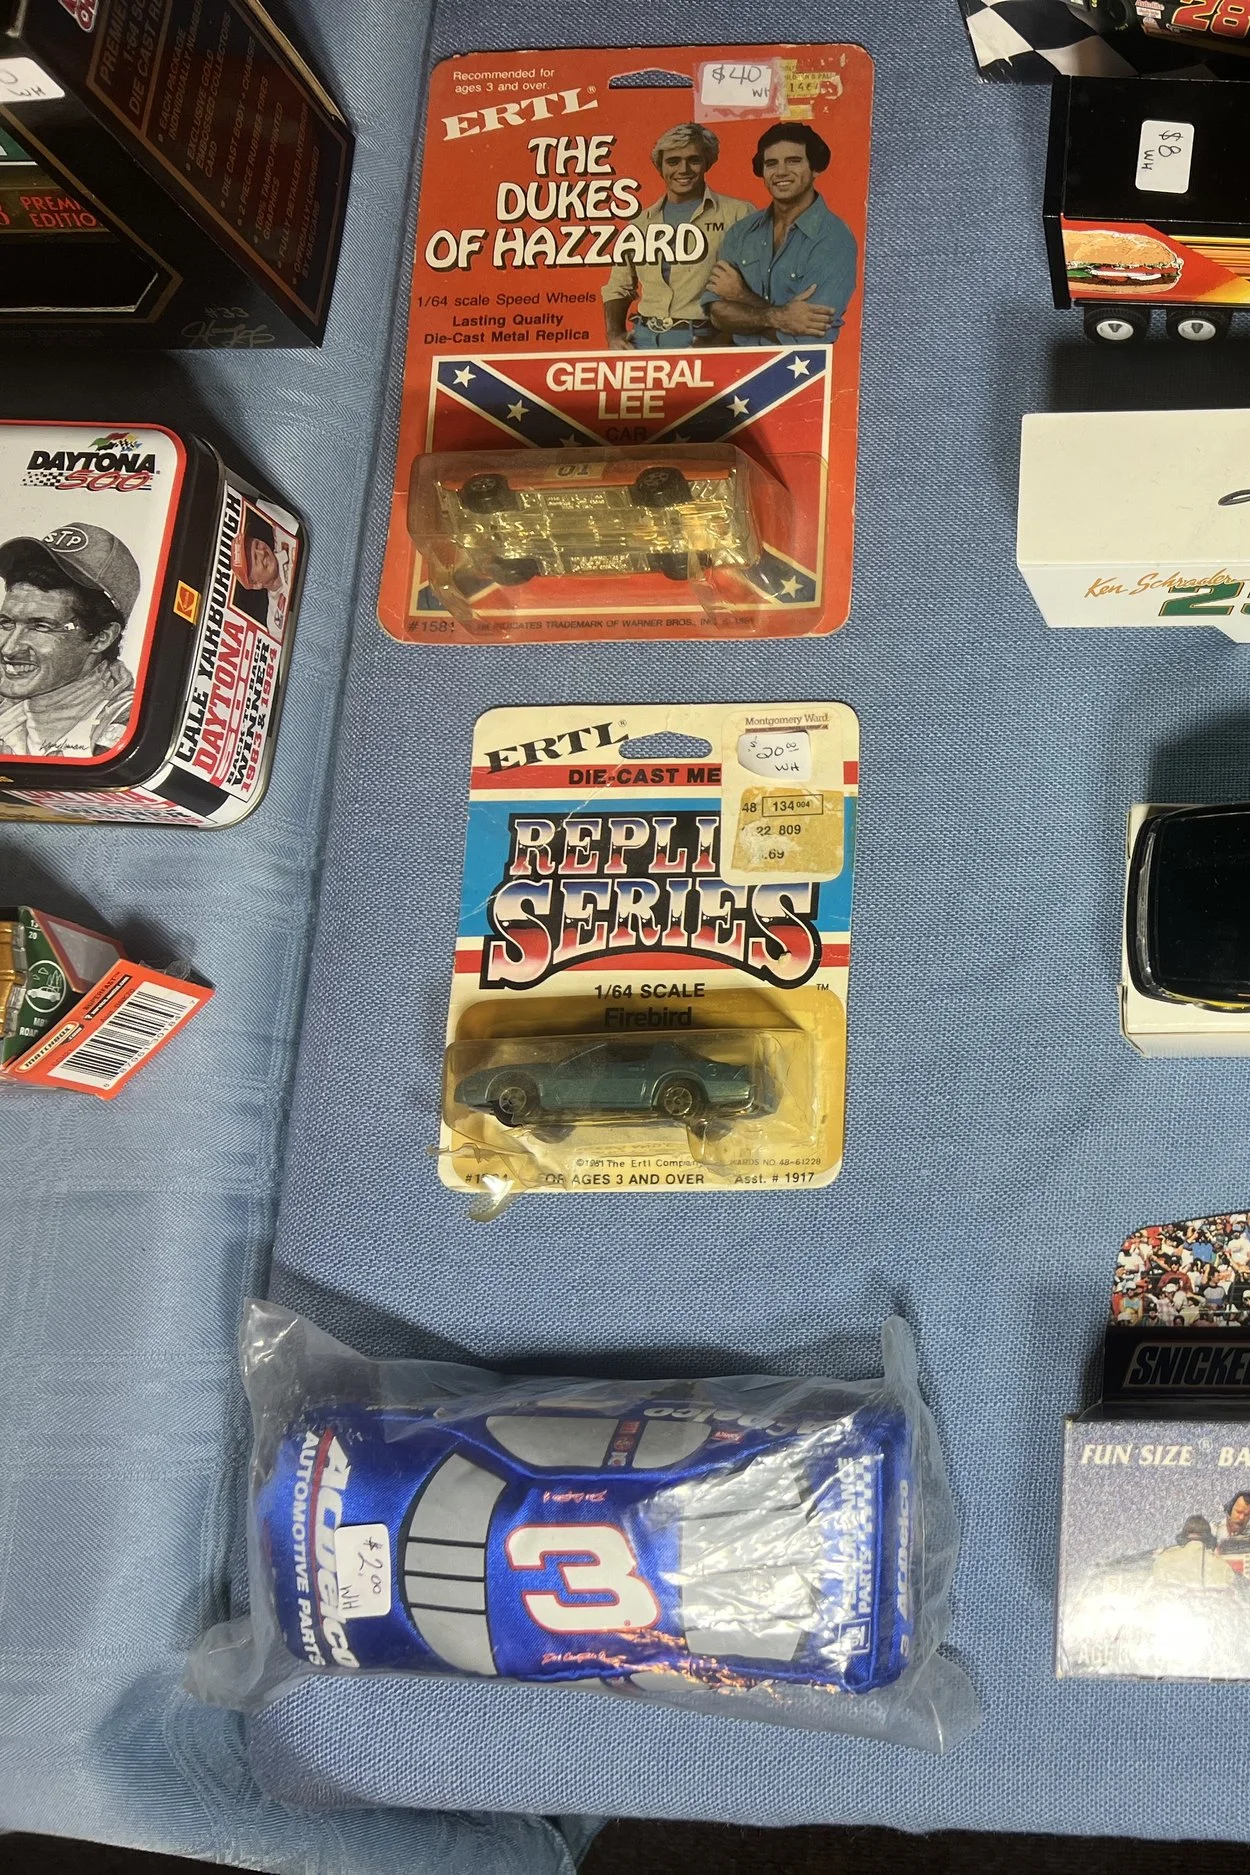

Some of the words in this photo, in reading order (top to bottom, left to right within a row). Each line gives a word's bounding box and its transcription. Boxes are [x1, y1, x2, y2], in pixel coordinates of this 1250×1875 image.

[452, 70, 533, 81] Recommended
[537, 68, 555, 78] for
[455, 83, 482, 94] ages
[486, 83, 494, 93] 3
[497, 81, 518, 92] and
[522, 81, 550, 91] over.
[440, 88, 600, 142] ERTL
[527, 134, 616, 176] THE
[1157, 128, 1184, 159] $8
[495, 177, 641, 222] DUKES
[424, 228, 488, 270] OF
[492, 222, 708, 268] HAZZARD
[417, 294, 449, 308] 1/64
[454, 293, 490, 307] scale
[495, 293, 540, 308] Speed
[545, 290, 597, 304] Wheels
[451, 314, 507, 330] Lasting
[511, 313, 564, 329] Quality
[423, 330, 487, 345] Die-Cast
[491, 329, 531, 343] Metal
[535, 327, 590, 343] Replica
[545, 358, 715, 392] GENERAL
[598, 389, 665, 420] LEE
[606, 425, 648, 442] CAR
[26, 449, 157, 475] DAYTONA
[57, 469, 153, 492] 500
[45, 528, 83, 548] STP
[1084, 576, 1129, 599] Ken
[176, 689, 209, 763] CALE
[201, 494, 244, 684] YARBOROUGH
[546, 619, 604, 630] TRADEMARK
[606, 619, 619, 629] OF
[622, 618, 663, 629] WARNER
[261, 645, 279, 708] 1984
[194, 620, 246, 776] DAYTONA
[234, 641, 271, 786] WINNER
[744, 714, 801, 728] Montgomery
[802, 711, 829, 723] Ward
[484, 721, 630, 775] ERTL
[567, 767, 681, 786] DIE-CAST
[771, 800, 795, 813] 134
[795, 799, 812, 809] 004
[778, 823, 802, 837] 809
[509, 816, 722, 877] REPLI
[485, 877, 818, 985] SERIES
[593, 983, 633, 999] 1/64
[640, 982, 706, 998] SCALE
[603, 1006, 694, 1029] Firebird
[23, 1025, 72, 1069] MATCHBOX
[571, 1172, 612, 1186] AGES
[615, 1173, 624, 1185] 3
[628, 1172, 661, 1186] AND
[665, 1172, 706, 1186] OVER
[734, 1173, 767, 1185] Asst.
[783, 1171, 816, 1184] 1917
[1080, 1444, 1133, 1465] FUN
[1138, 1444, 1194, 1467] SIZE
[291, 1430, 321, 1595] AUTOMOTIVE
[504, 1522, 663, 1636] 3
[297, 1598, 326, 1667] PARTS
